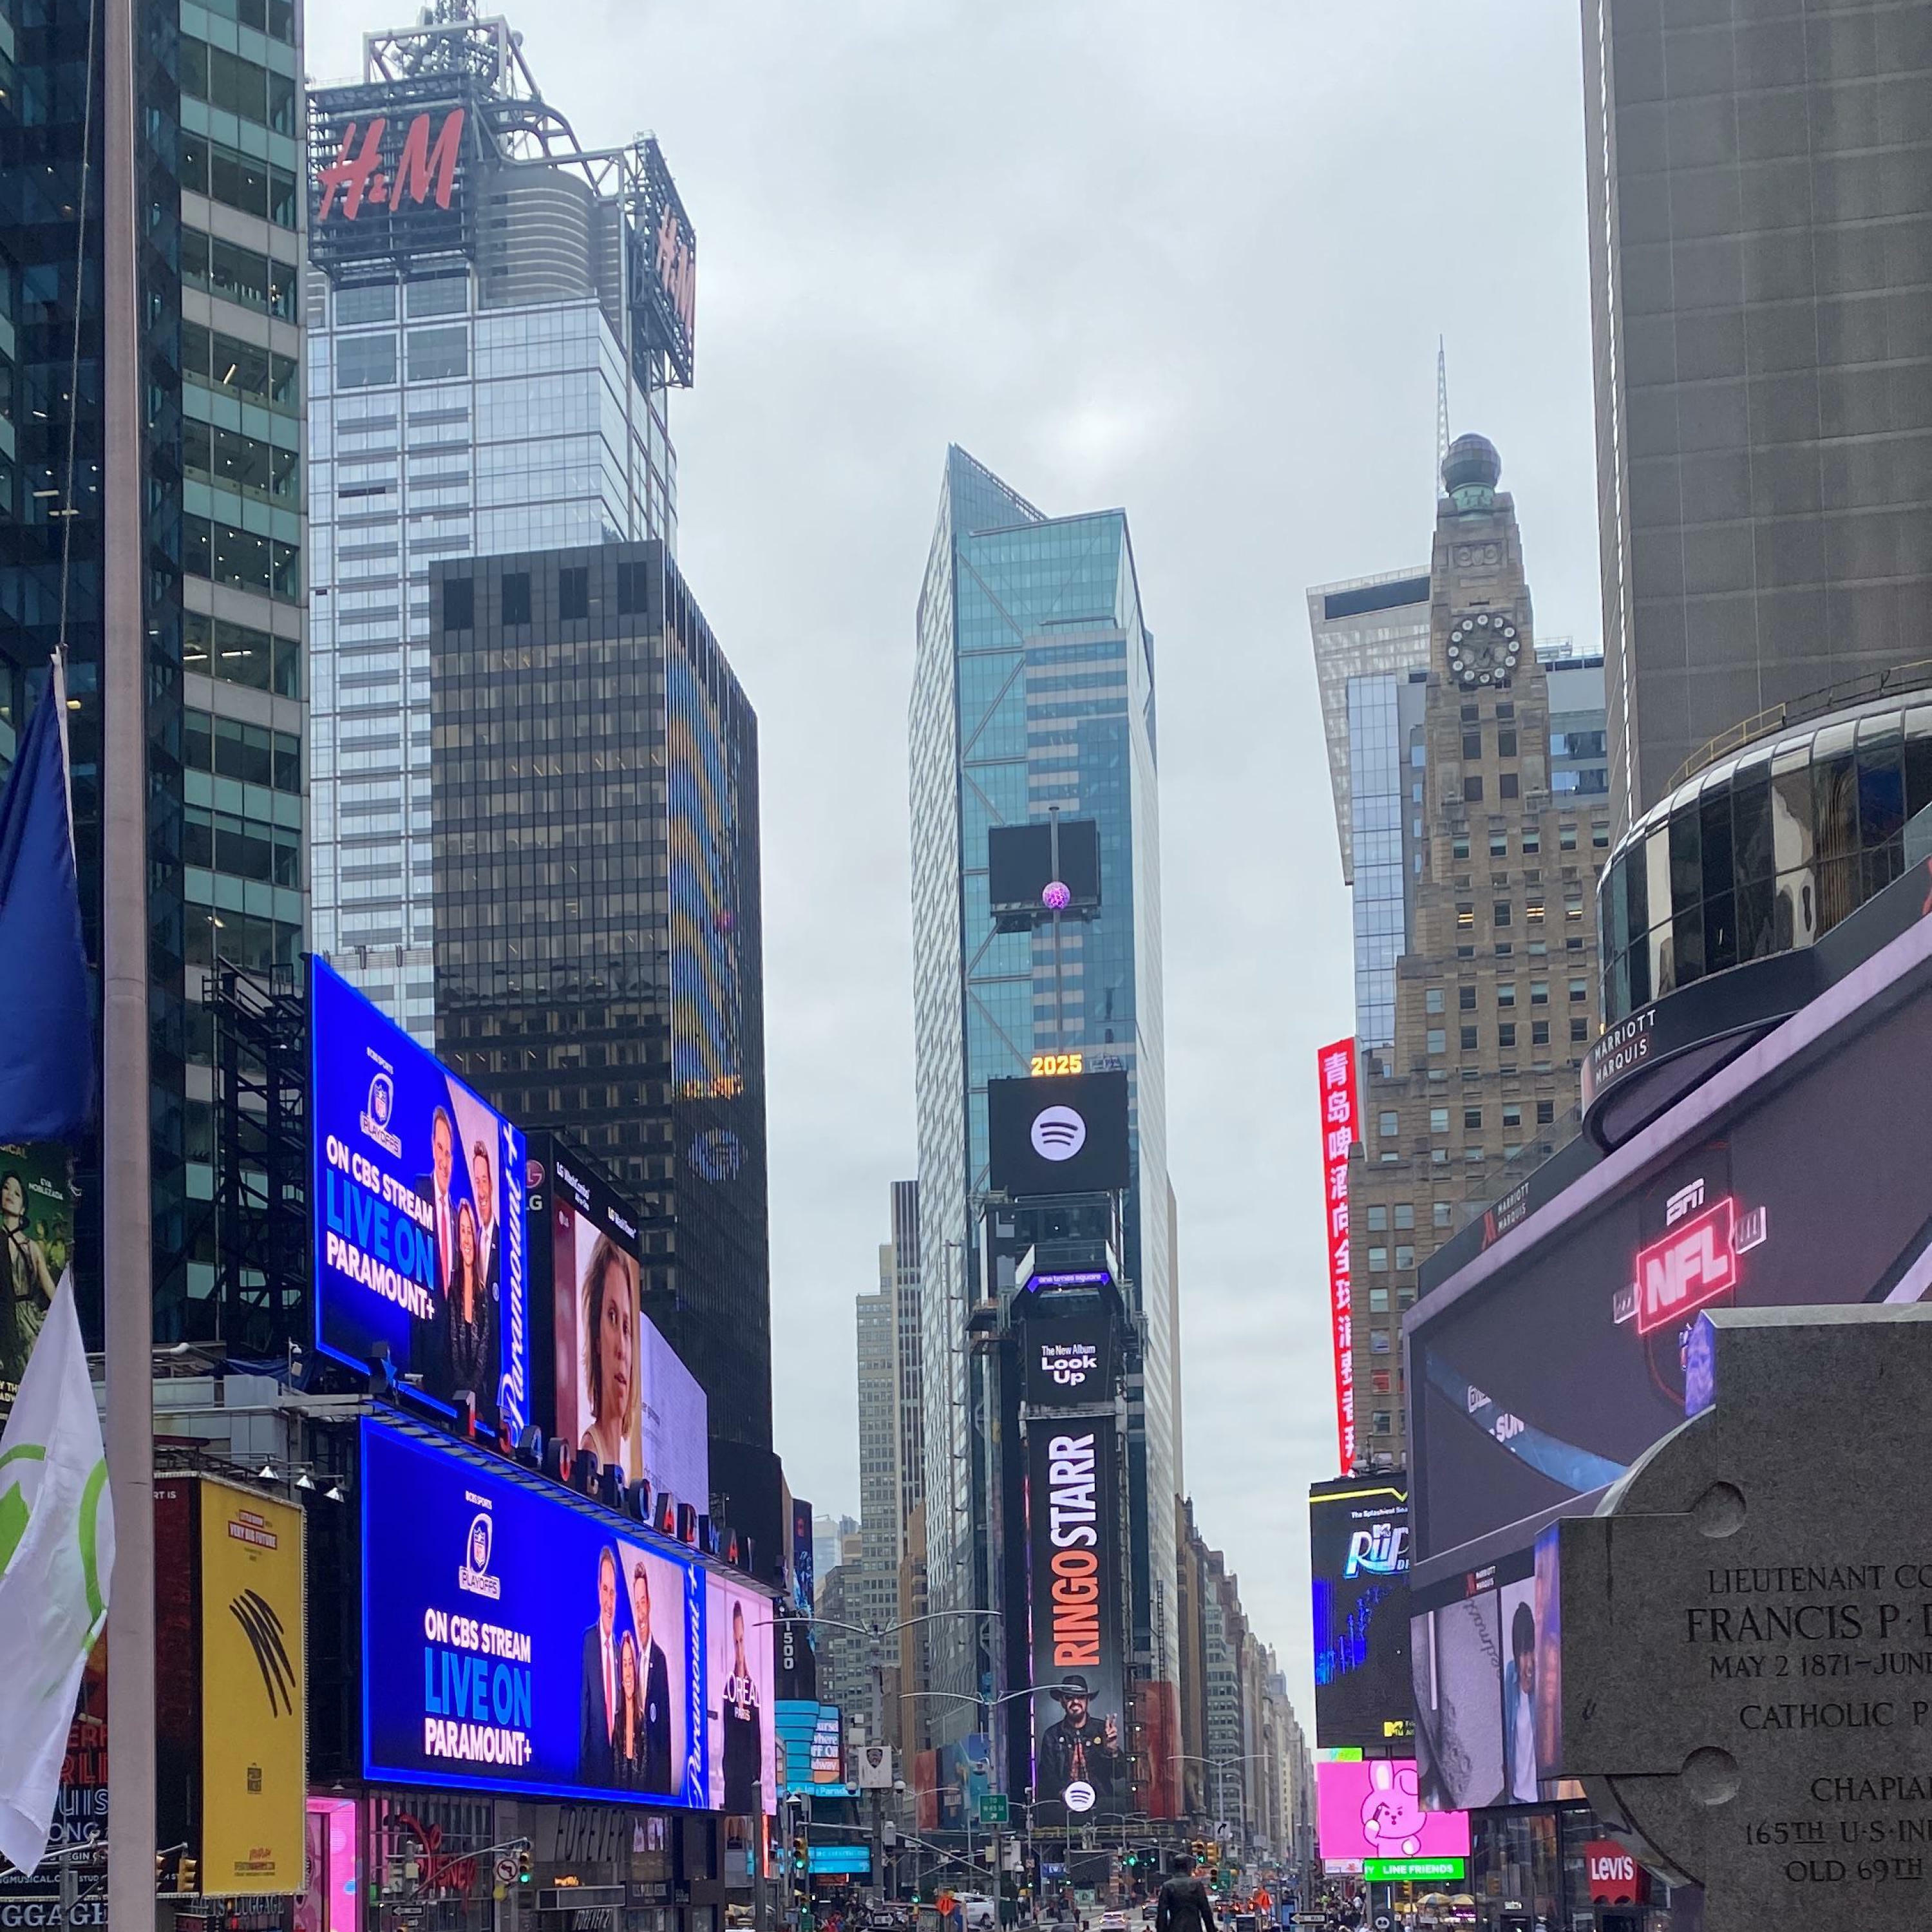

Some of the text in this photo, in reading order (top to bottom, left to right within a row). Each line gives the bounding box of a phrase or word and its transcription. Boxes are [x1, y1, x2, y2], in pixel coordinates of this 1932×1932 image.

[317, 108, 465, 221] H&M
[1595, 1009, 1656, 1063] MARRIOTT
[1030, 1054, 1082, 1076] 2025
[1596, 1039, 1647, 1087] MARQUIS
[363, 1117, 399, 1153] PLAYOFFS
[327, 1134, 433, 1231] ON CBS STREAM
[1498, 1182, 1529, 1217] MARRIOTT
[1665, 1178, 1705, 1226] ESPN
[327, 1168, 434, 1291] LIVE ON
[327, 1231, 435, 1320] PARAMOUNT+
[1646, 1226, 1728, 1315] NFL
[1041, 1343, 1096, 1356] The New Album
[1041, 1355, 1097, 1370] Look
[1054, 1370, 1086, 1386] Up
[167, 1491, 177, 1499] IS
[1048, 1433, 1097, 1547] STARR
[461, 1569, 498, 1595] PLAYOFFS
[1709, 1566, 1886, 1594] LIEUTENANT
[1050, 1549, 1101, 1667] RINGO
[1685, 1604, 1863, 1643] FRANCIS
[424, 1607, 531, 1663] ON CBS STREAM
[783, 1621, 795, 1670] 1500
[1710, 1655, 1766, 1678] MAY
[1776, 1655, 1788, 1676] 2
[424, 1646, 531, 1729] LIVE ON
[1740, 1701, 1895, 1730] CATHOLIC
[424, 1718, 533, 1766] PARAMOUNT+
[1746, 1819, 1827, 1846] 165TH
[1383, 1864, 1407, 1875] LINE
[1408, 1864, 1454, 1875] FRIENDS
[1785, 1858, 1923, 1883] OLD 69TH
